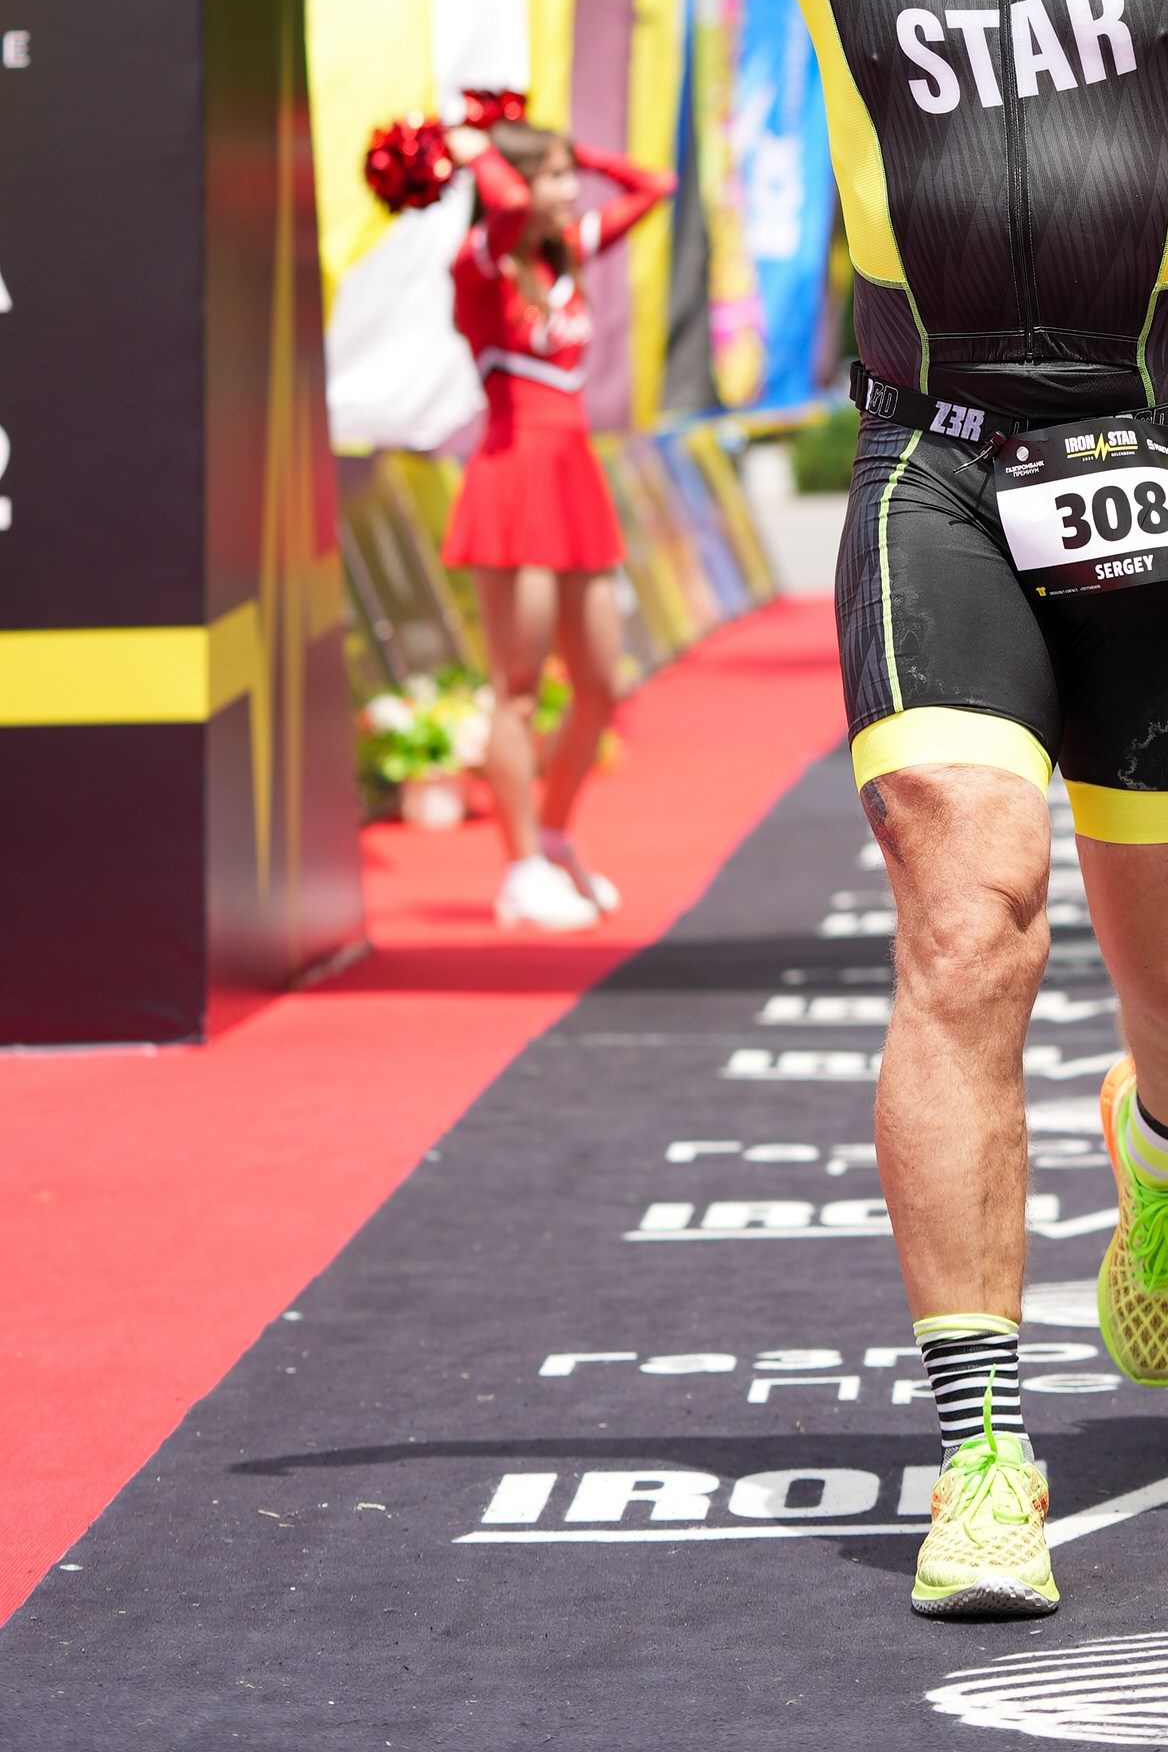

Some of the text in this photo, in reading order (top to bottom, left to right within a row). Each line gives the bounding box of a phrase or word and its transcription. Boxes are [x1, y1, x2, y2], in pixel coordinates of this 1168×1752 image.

[1065, 430, 1138, 454] IRON STAR
[1095, 554, 1154, 580] SERGEY
